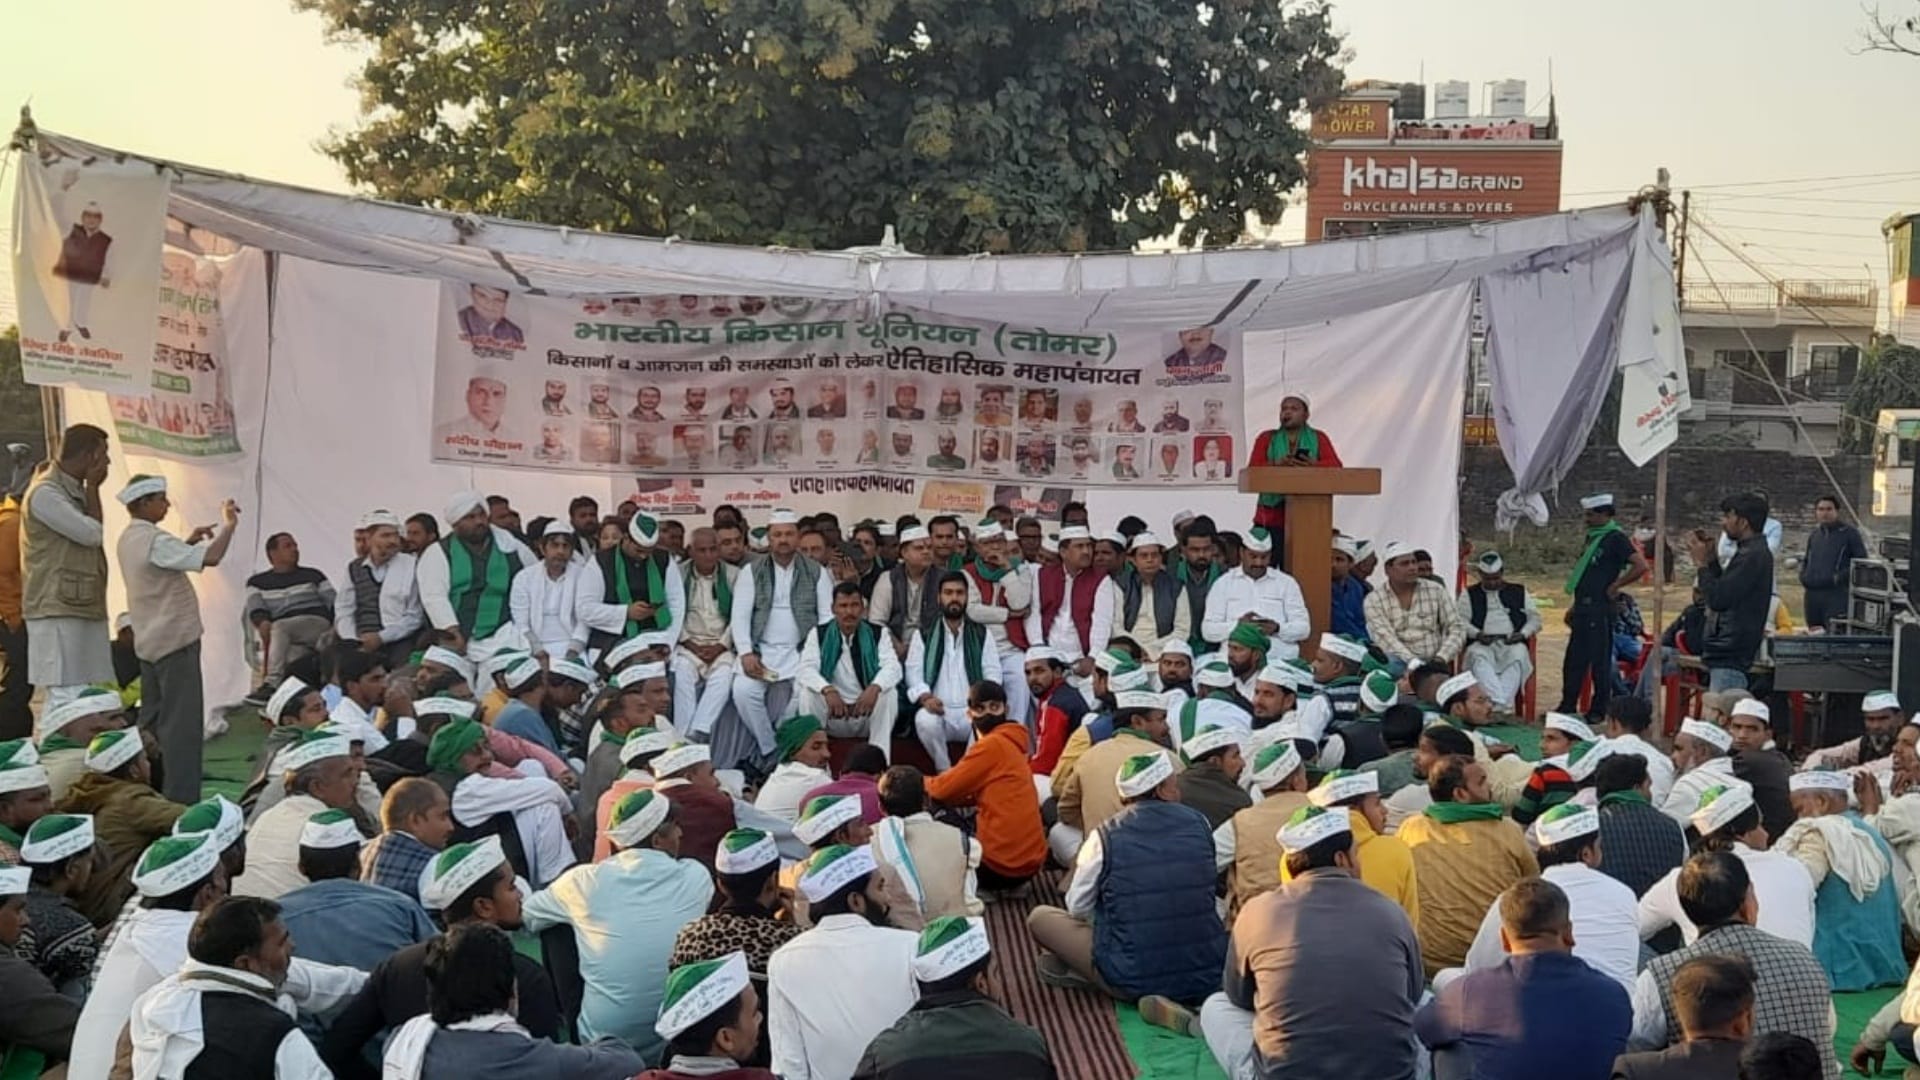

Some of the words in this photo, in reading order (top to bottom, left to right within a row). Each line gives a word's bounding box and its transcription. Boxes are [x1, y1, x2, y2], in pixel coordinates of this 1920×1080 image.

[1323, 119, 1376, 133] OWER
[1453, 202, 1463, 213] &
[1466, 202, 1513, 213] DYERS
[574, 318, 713, 345] भारतीय
[723, 317, 844, 345] किसान
[856, 313, 980, 348] यूनियन
[993, 322, 1117, 364] (तोमर)
[634, 359, 704, 374] आमजन
[709, 355, 733, 373] की
[818, 353, 841, 369] को
[845, 352, 885, 370] लेकर
[886, 345, 1008, 378] ऐतिहासिक
[1013, 360, 1143, 386] महापंचायत
